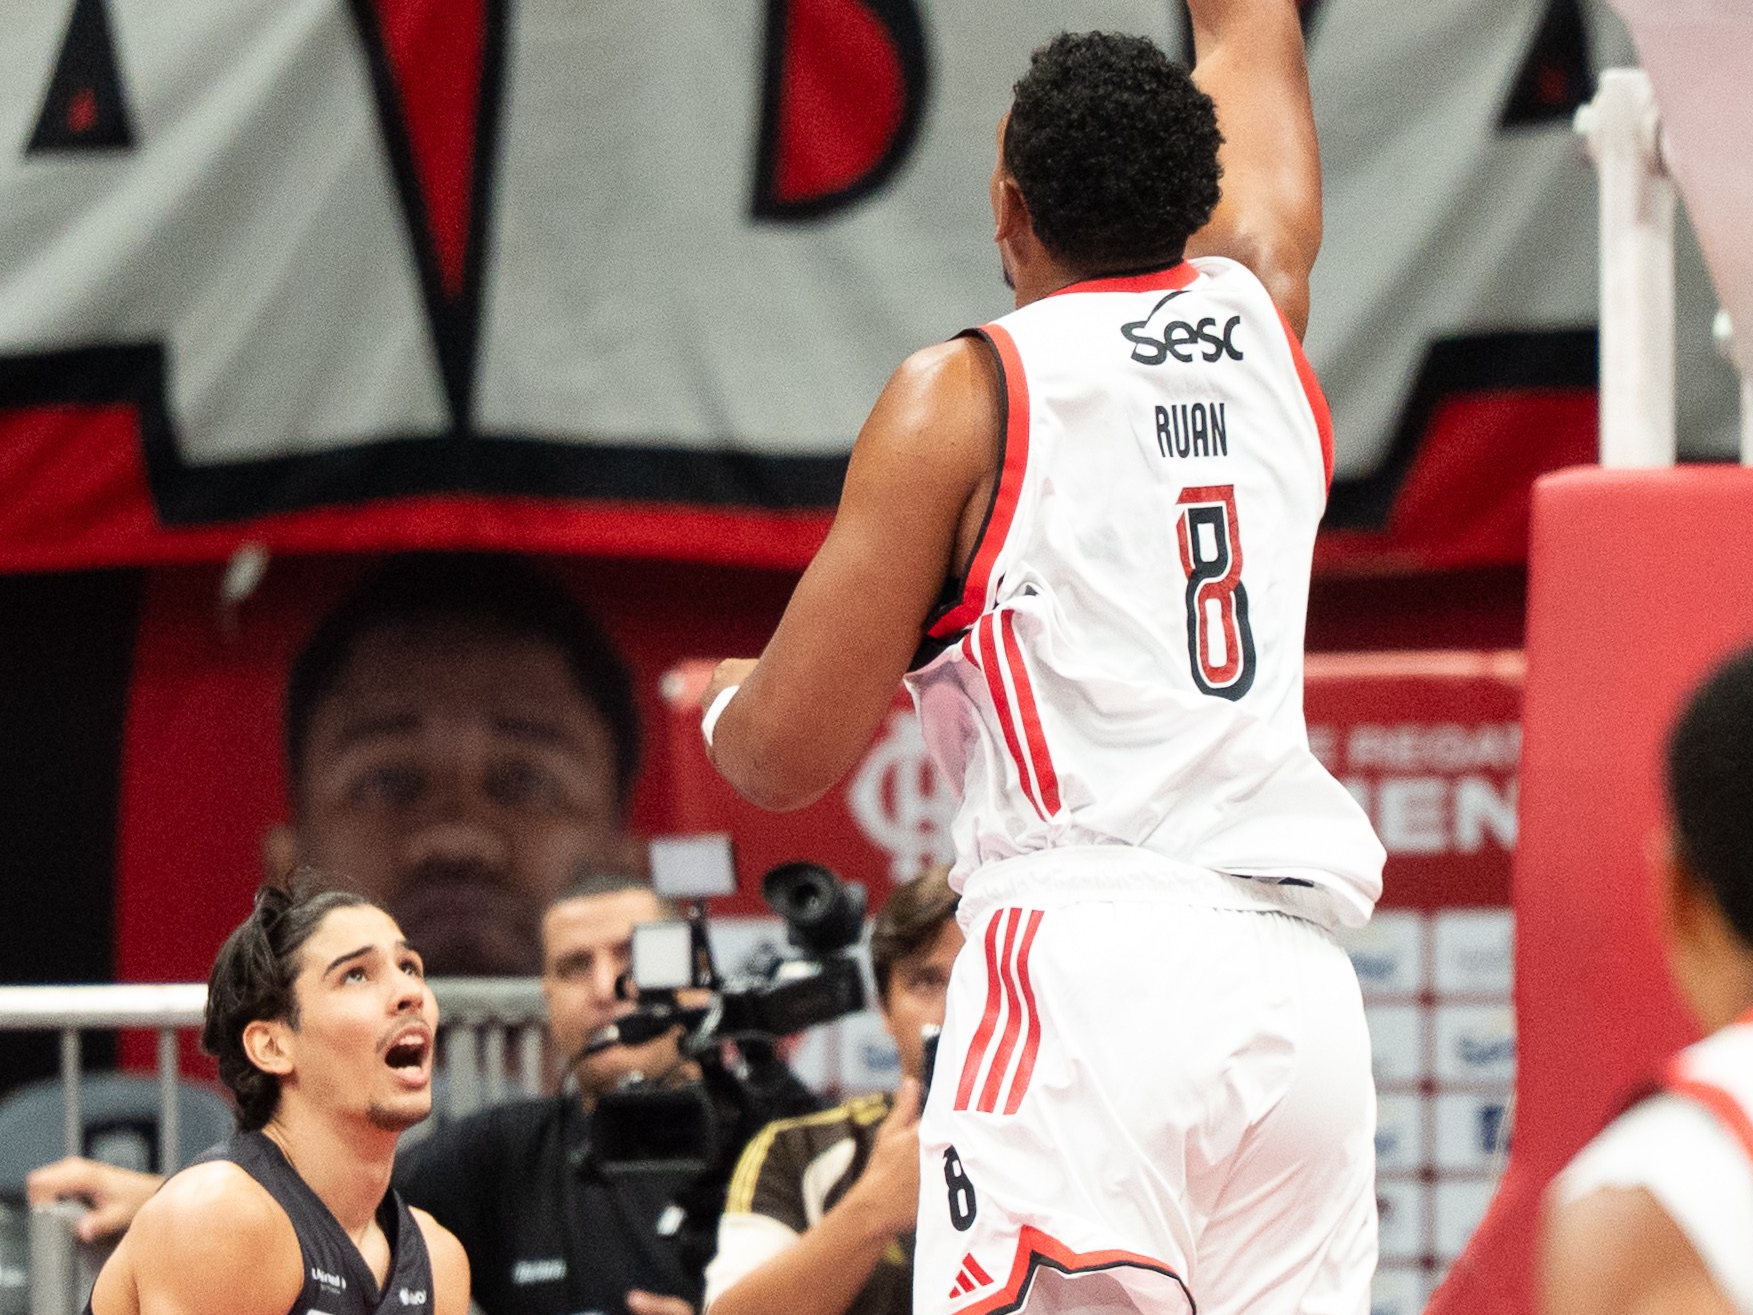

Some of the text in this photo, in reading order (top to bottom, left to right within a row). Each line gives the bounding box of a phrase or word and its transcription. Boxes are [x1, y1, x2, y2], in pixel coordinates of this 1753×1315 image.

[1155, 402, 1228, 459] RUAN
[1176, 483, 1257, 703] 8
[942, 1144, 978, 1233] 8
